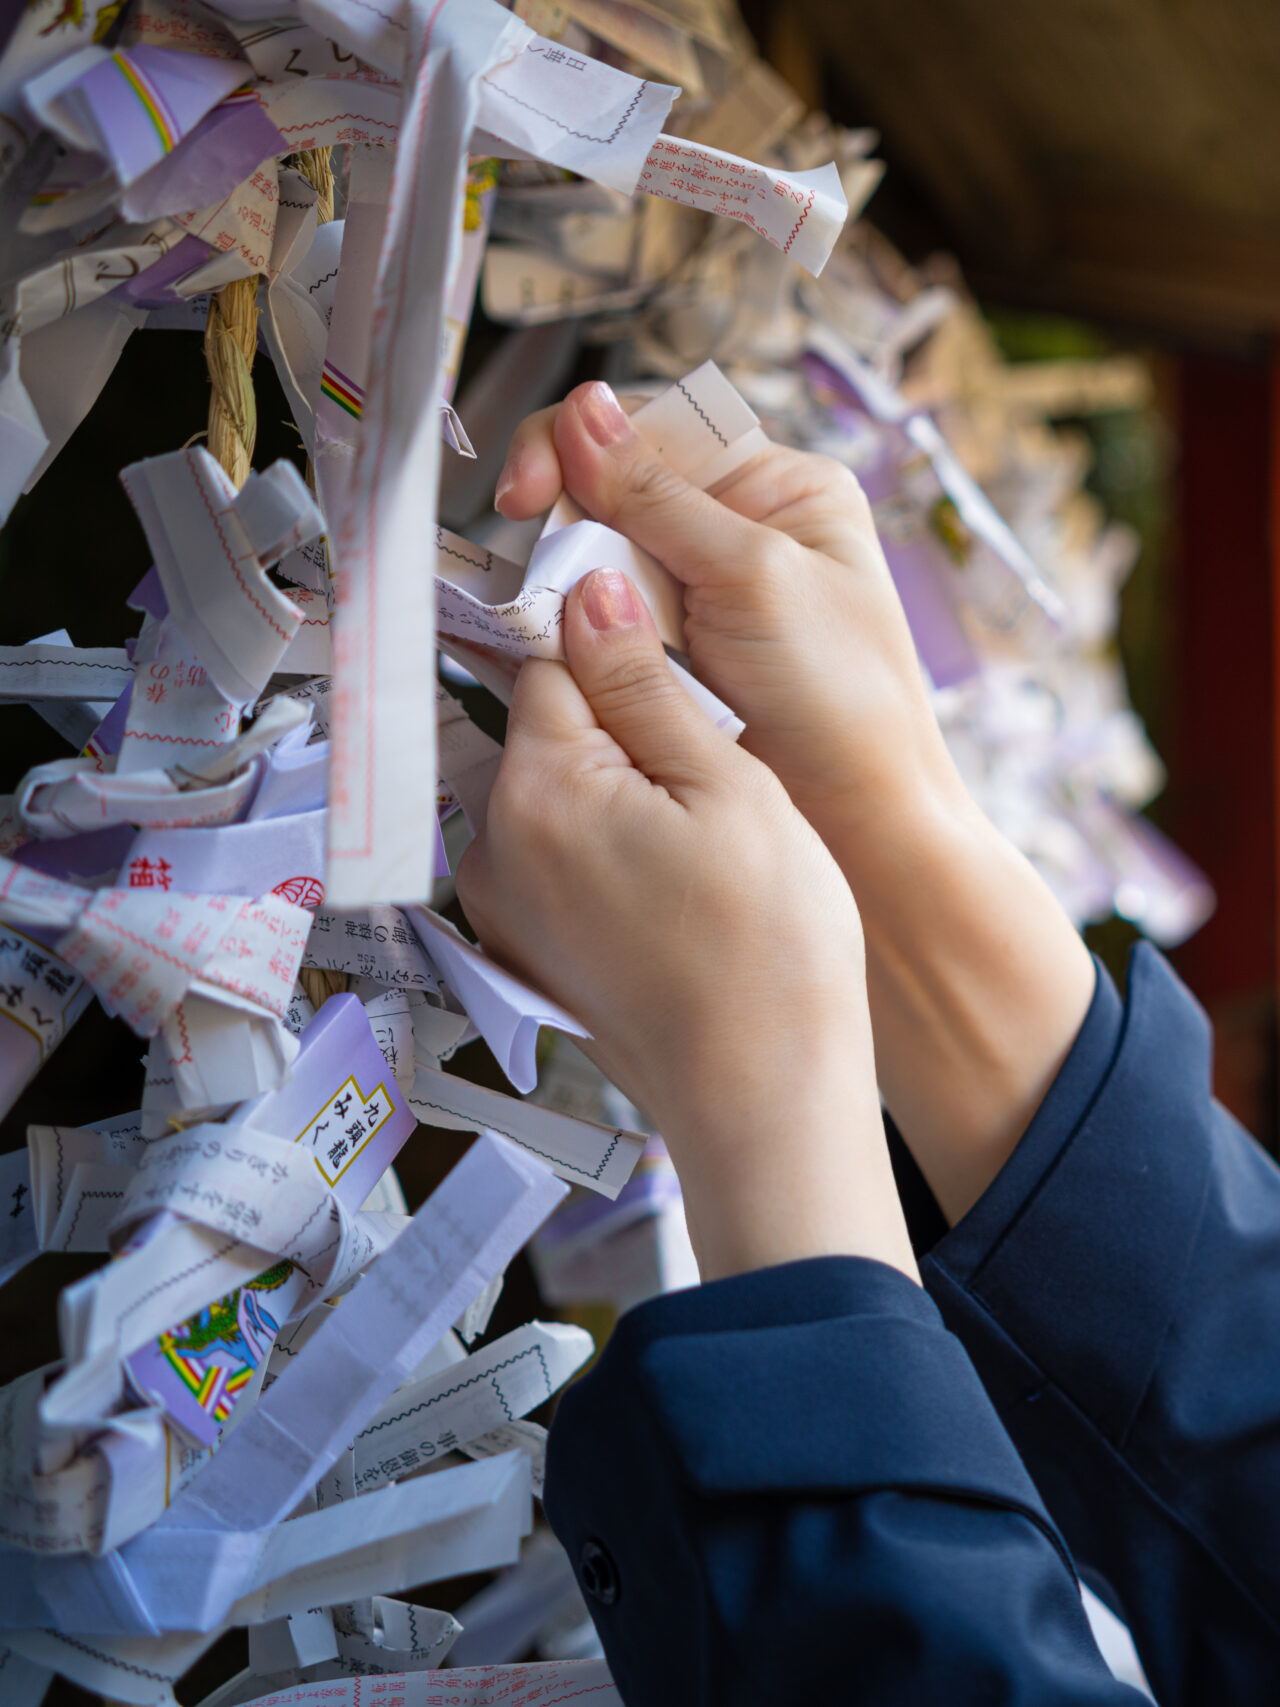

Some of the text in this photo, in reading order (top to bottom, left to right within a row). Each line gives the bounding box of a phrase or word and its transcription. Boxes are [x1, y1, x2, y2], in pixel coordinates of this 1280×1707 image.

[313, 1091, 352, 1145] みく
[326, 1103, 379, 1169] 九頭龍
